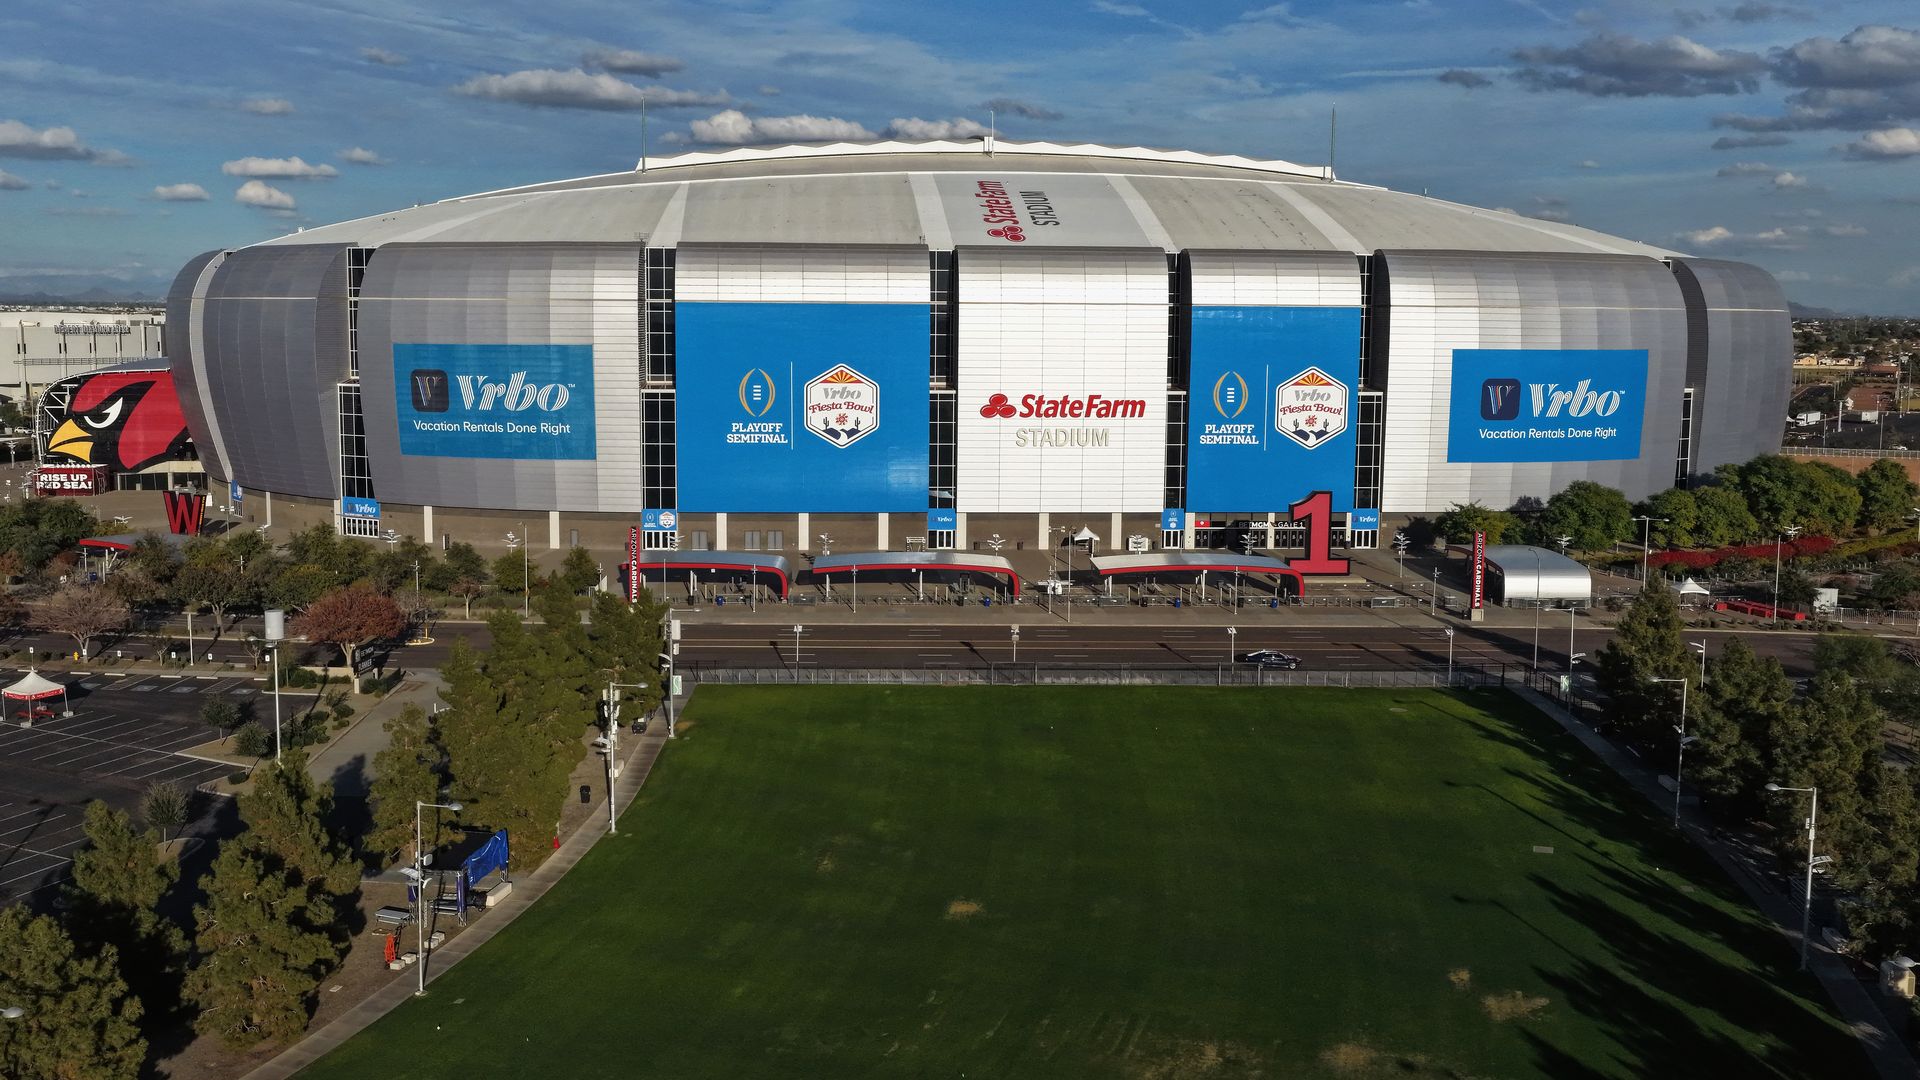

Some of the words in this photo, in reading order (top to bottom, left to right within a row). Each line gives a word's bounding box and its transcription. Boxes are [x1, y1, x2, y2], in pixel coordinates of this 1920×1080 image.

[1019, 191, 1060, 226] STADIUM
[823, 386, 862, 400] Vrbo
[1294, 388, 1331, 402] Vrbo
[809, 402, 842, 414] Fiesta
[844, 402, 874, 414] Bowl
[1280, 404, 1312, 416] Fiesta
[1313, 403, 1343, 416] Bowl
[413, 420, 460, 432] Vacation
[463, 422, 504, 433] Rentals
[507, 422, 537, 433] Done
[541, 423, 571, 435] Right
[732, 422, 783, 433] PLAYOFF
[1205, 424, 1255, 434] PLAYOFF
[1479, 428, 1526, 439] Vacation
[1529, 428, 1565, 439] Rentals
[1568, 427, 1592, 438] Done
[1595, 427, 1617, 440] Right
[726, 433, 788, 444] SEMIFINAL
[1015, 428, 1110, 447] STADIUM
[1199, 435, 1259, 445] SEMIFINAL
[63, 481, 92, 489] SEA!
[355, 503, 376, 514] Vrbo
[1285, 490, 1350, 576] 1
[1474, 564, 1482, 607] CARDINALS
